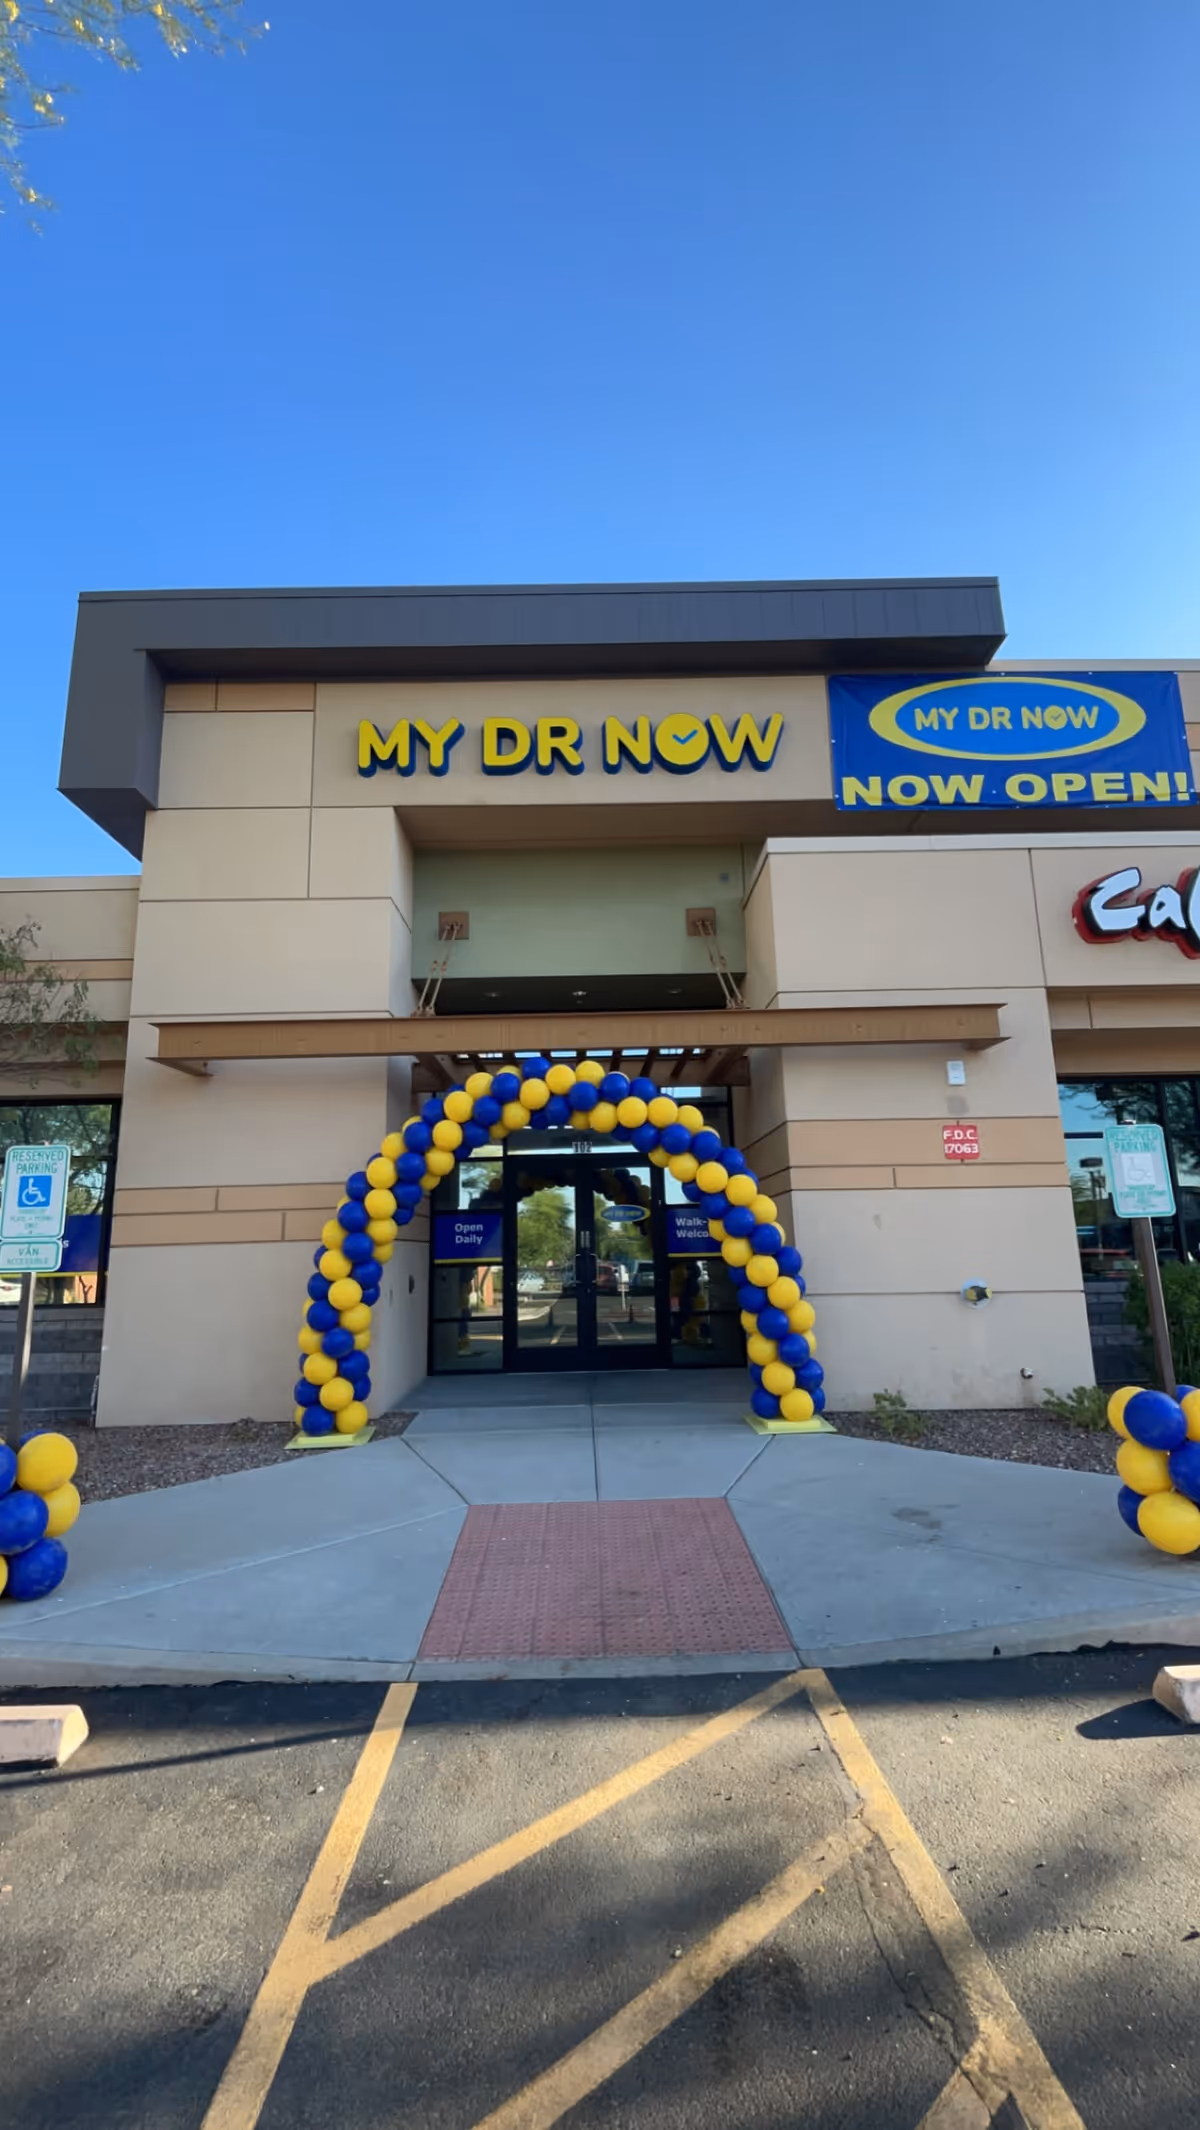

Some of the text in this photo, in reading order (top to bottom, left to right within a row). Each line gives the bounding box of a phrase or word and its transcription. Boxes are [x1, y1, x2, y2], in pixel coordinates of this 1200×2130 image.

[913, 705, 1099, 731] MY DR NOW
[358, 712, 784, 777] MY DR NOW
[842, 772, 1191, 806] NOW OPEN!
[1072, 865, 1200, 960] Ca
[12, 1150, 64, 1162] RESERVED
[16, 1161, 58, 1174] PARKING
[675, 1217, 709, 1227] Walk-
[454, 1223, 484, 1234] Open
[676, 1229, 709, 1238] Welco
[455, 1234, 484, 1245] Daily
[18, 1247, 40, 1256] VAN
